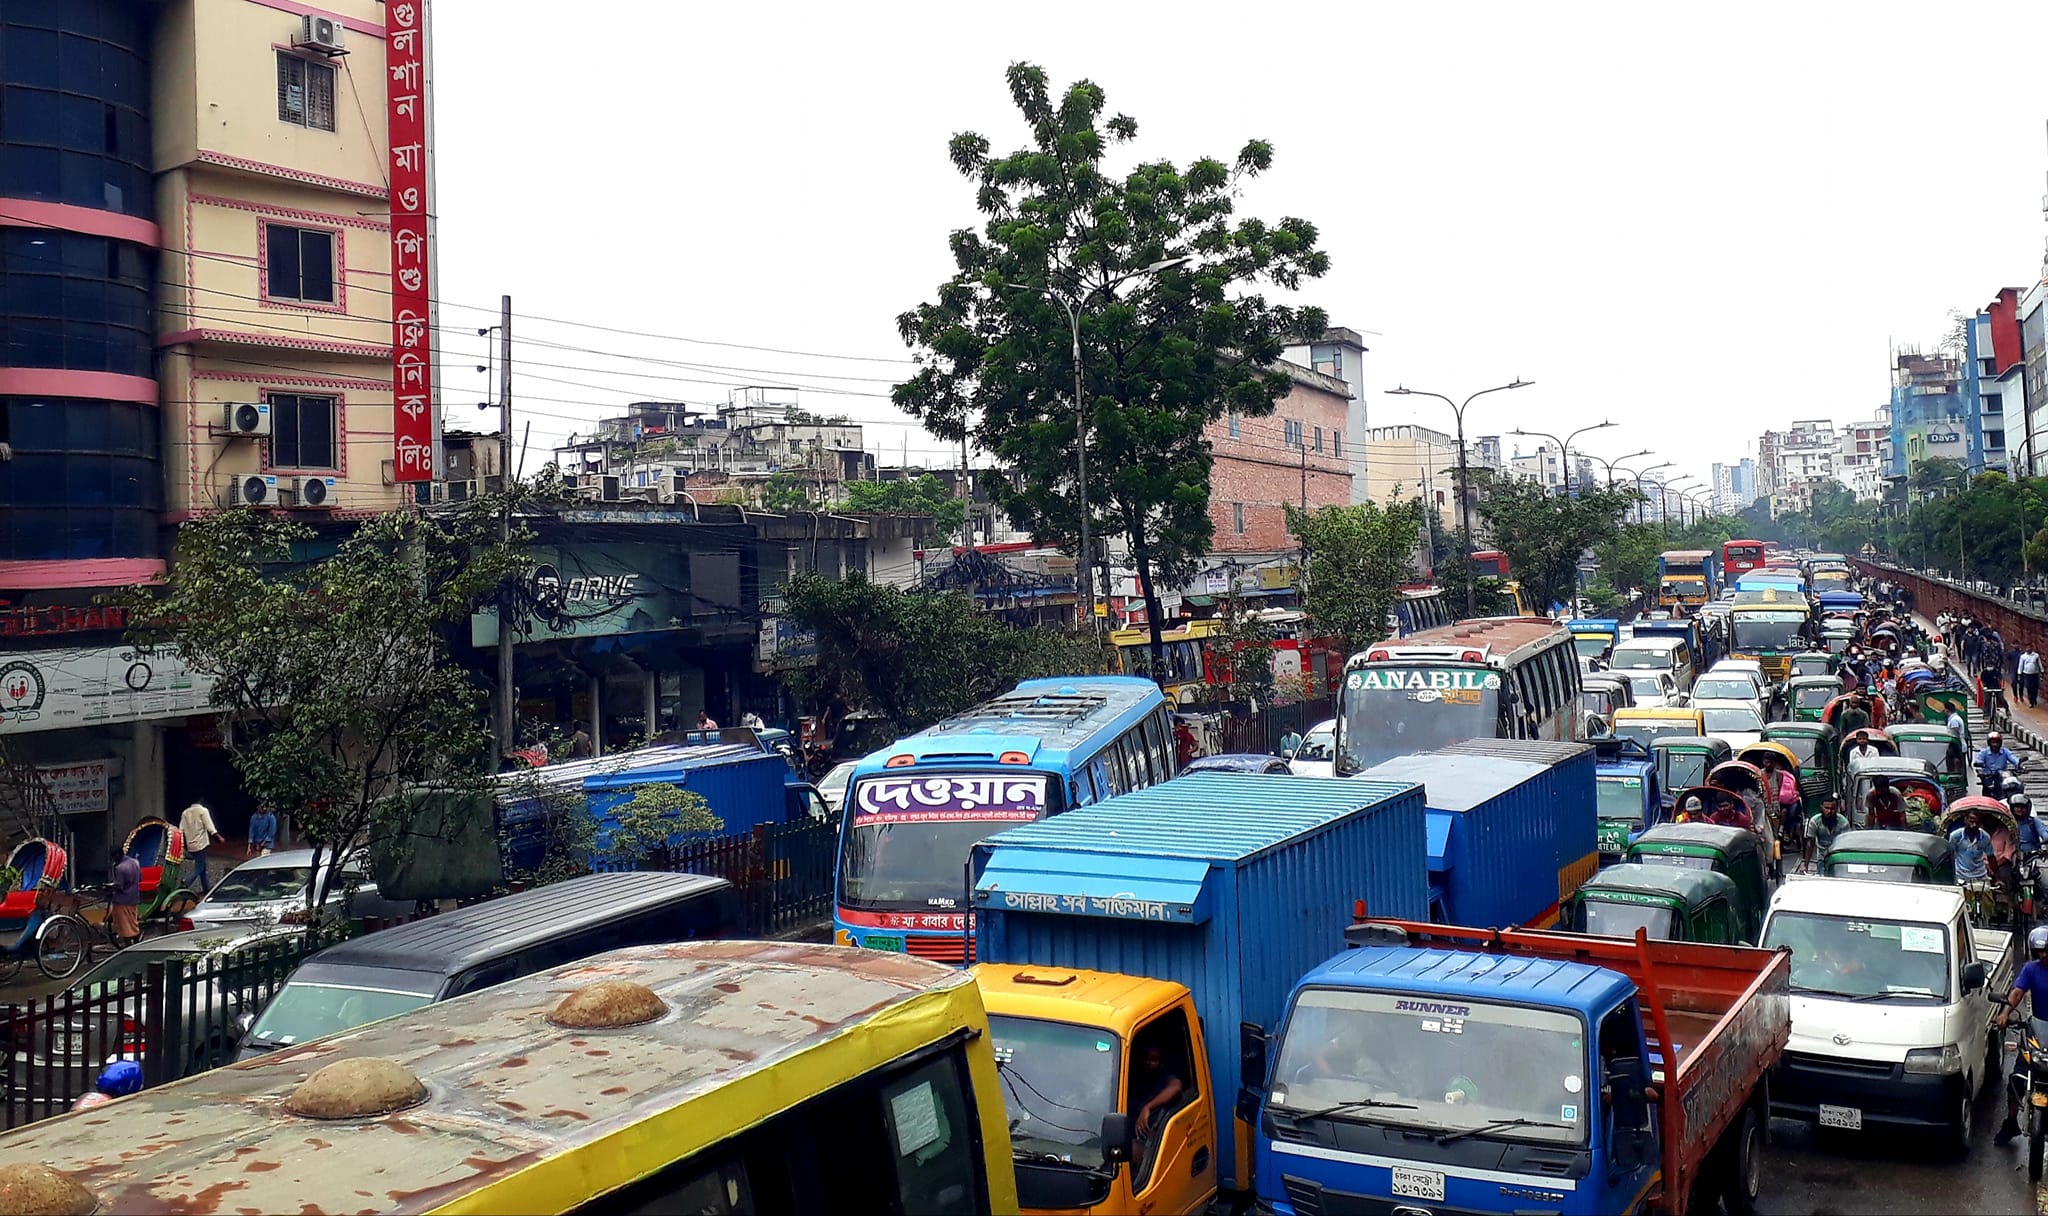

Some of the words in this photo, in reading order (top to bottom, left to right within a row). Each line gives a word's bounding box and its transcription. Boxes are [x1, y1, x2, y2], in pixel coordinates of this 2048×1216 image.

[565, 573, 640, 601] DRIVE
[1361, 670, 1484, 690] ANABIL
[857, 778, 1047, 815] দেওয়ান
[1005, 891, 1060, 911] আল্লাহ
[921, 915, 949, 928] বাবার
[1395, 1000, 1471, 1016] RUNNER
